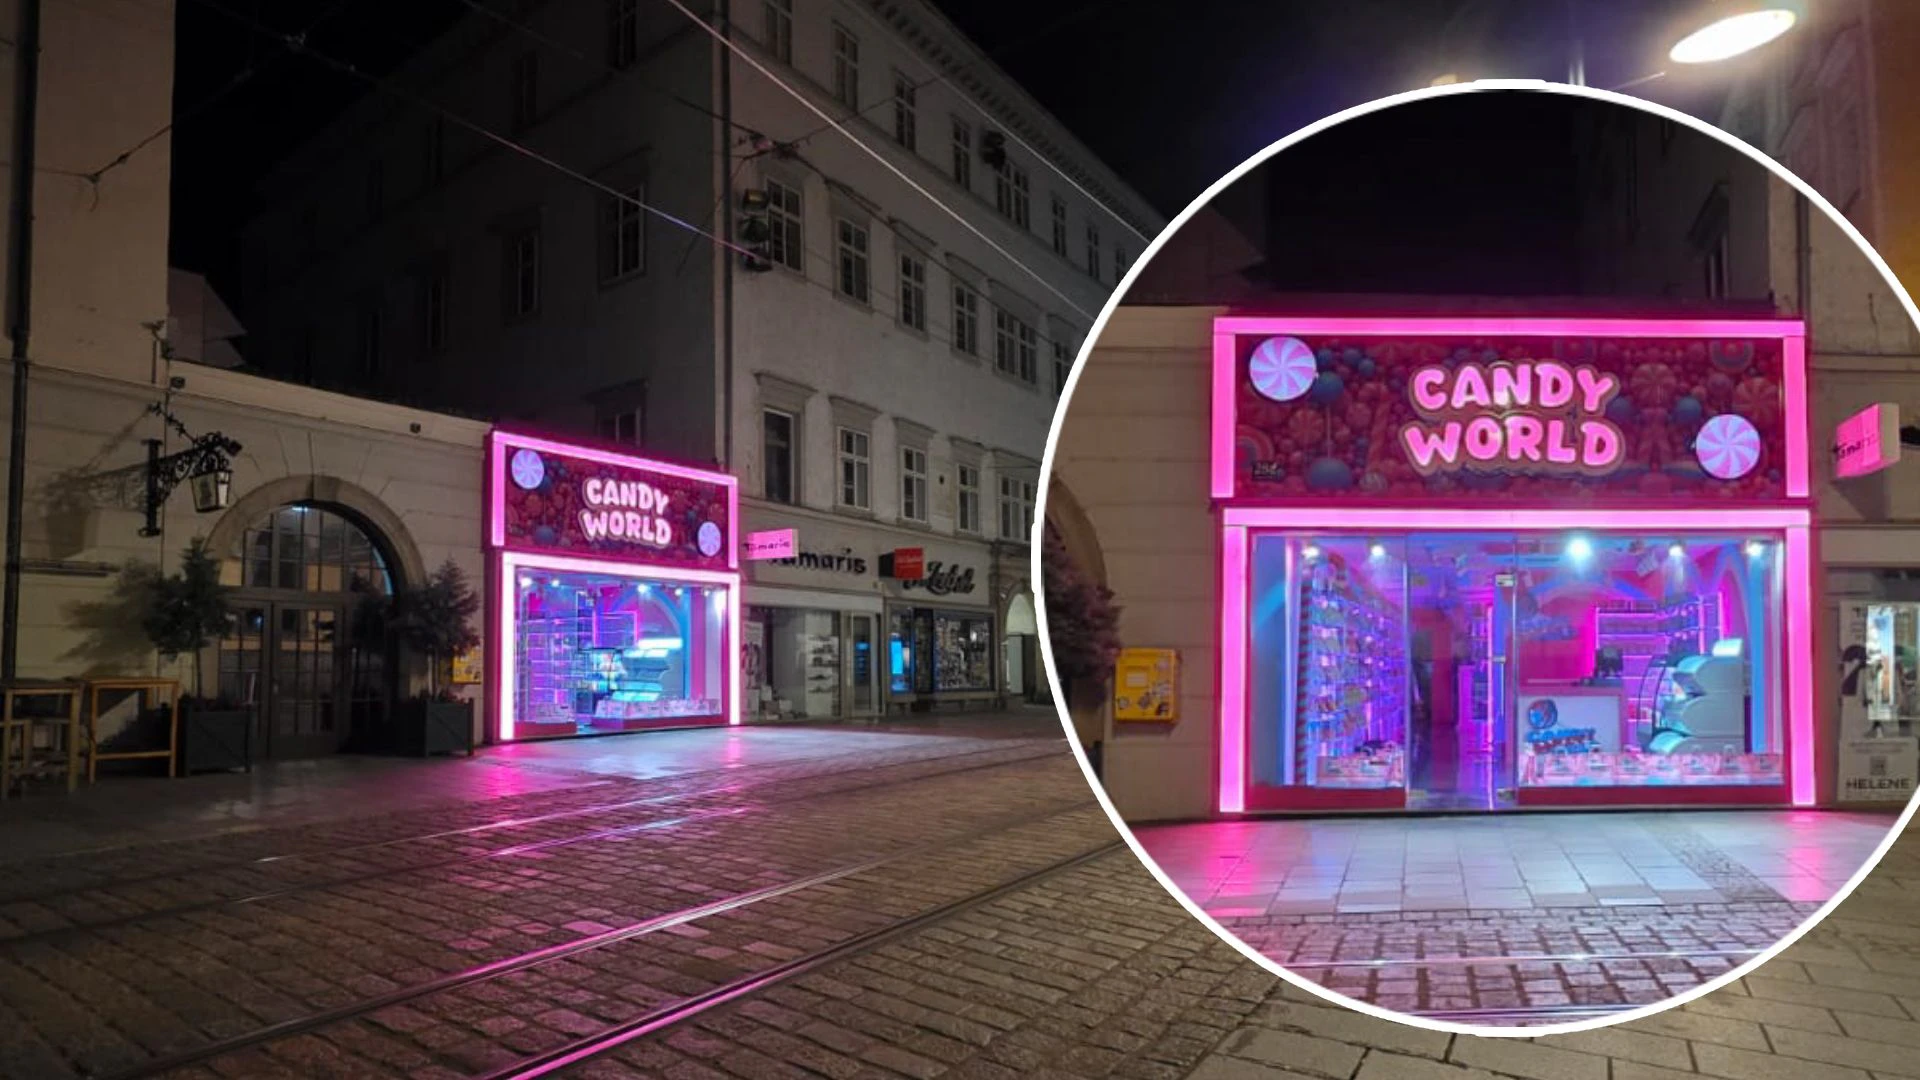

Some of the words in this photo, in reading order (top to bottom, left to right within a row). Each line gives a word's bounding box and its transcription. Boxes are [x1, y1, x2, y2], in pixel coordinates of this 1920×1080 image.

[1413, 362, 1614, 412] CANDY
[1404, 415, 1619, 467] WORLD
[585, 479, 670, 515] CANDY
[582, 510, 672, 544] WORLD
[1845, 778, 1911, 790] HELENE
